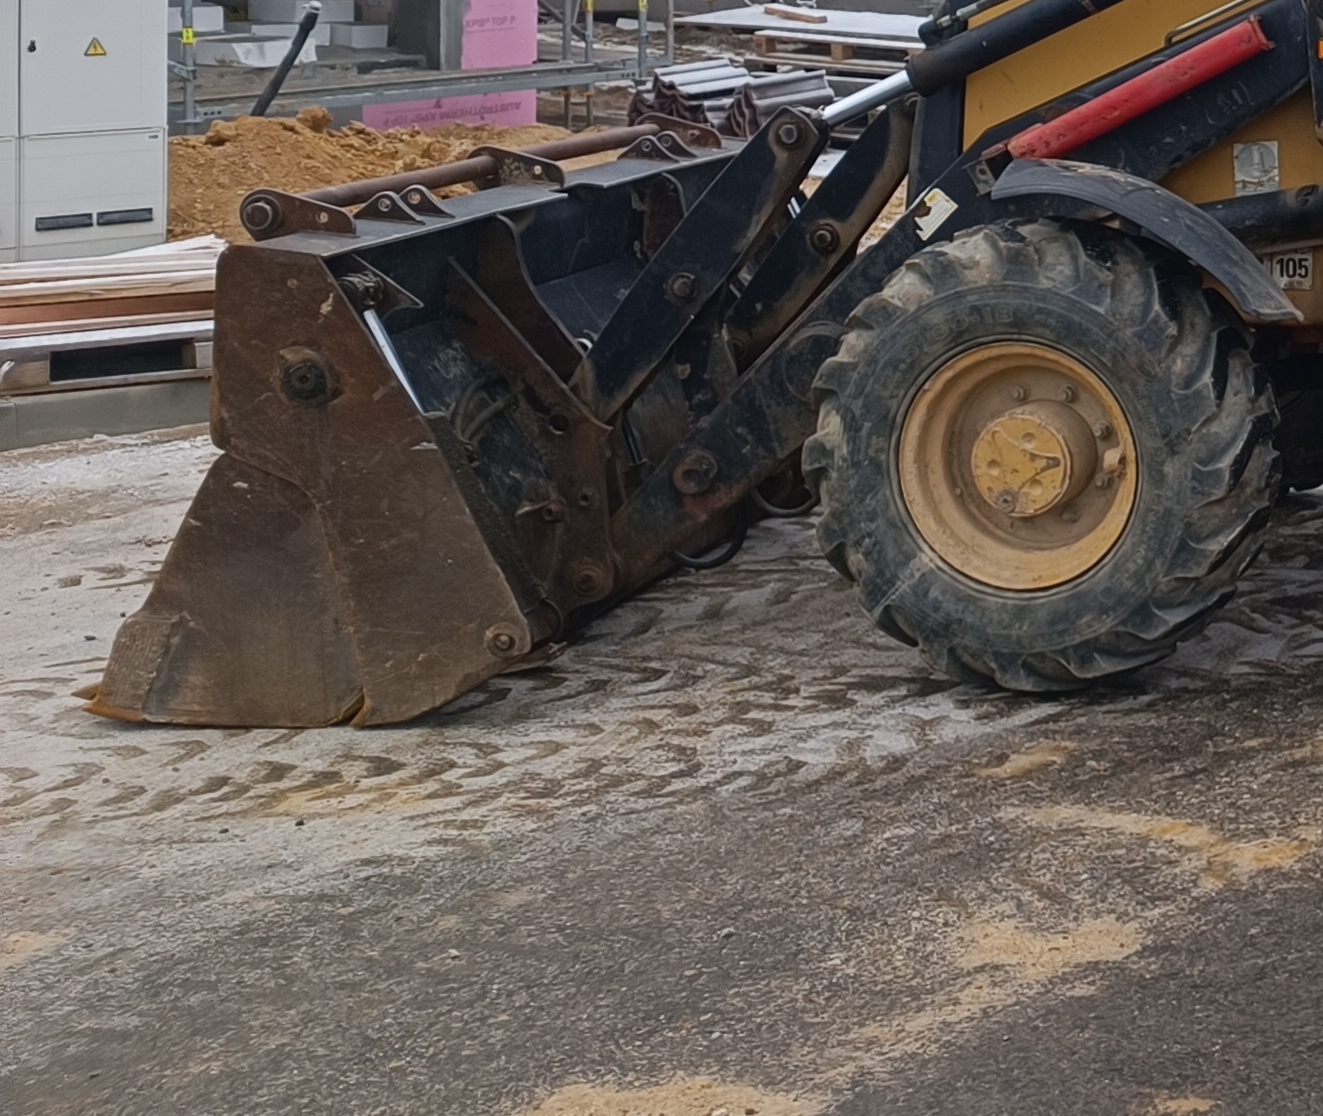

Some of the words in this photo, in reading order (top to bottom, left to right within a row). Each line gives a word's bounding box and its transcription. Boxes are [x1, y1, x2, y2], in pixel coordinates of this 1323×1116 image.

[491, 16, 508, 26] TOP
[439, 101, 522, 120] AUSTROTHERM
[1275, 257, 1309, 279] 105
